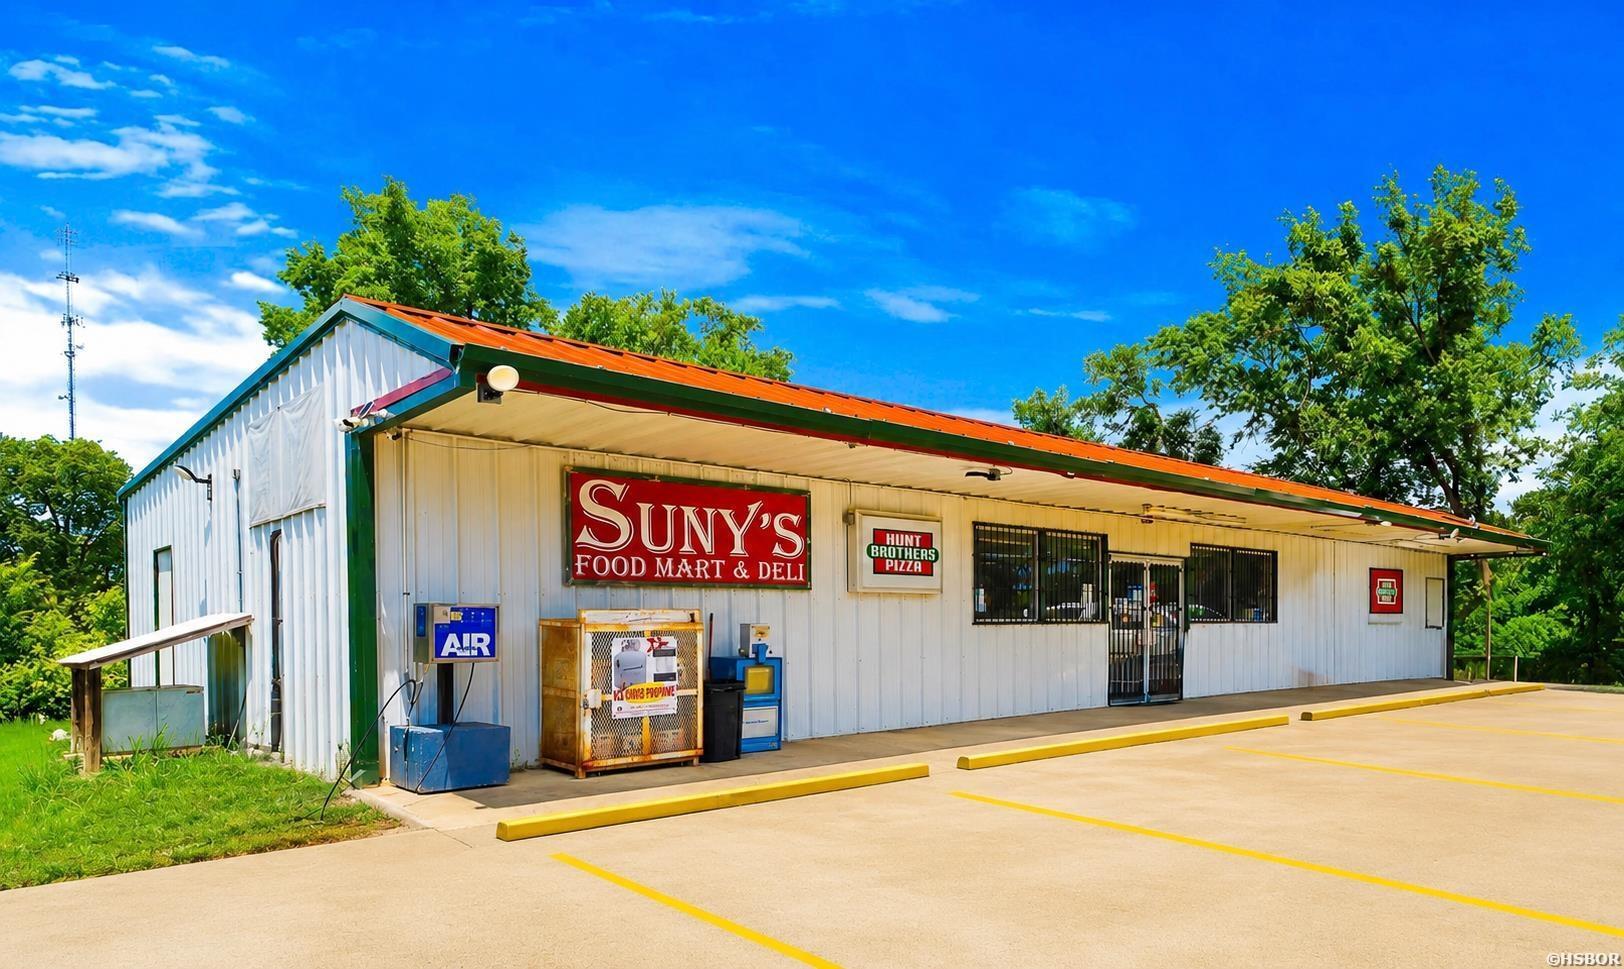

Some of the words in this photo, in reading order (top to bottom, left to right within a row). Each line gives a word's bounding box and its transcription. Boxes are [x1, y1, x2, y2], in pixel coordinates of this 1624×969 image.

[575, 479, 804, 559] SUNY'S
[886, 533, 921, 547] HUNT
[871, 545, 935, 561] BROTHERS
[575, 554, 646, 577] FOOD
[655, 558, 725, 579] MART
[733, 561, 749, 579] &
[758, 561, 805, 581] DELI
[886, 560, 922, 572] PIZZA
[440, 633, 491, 656] AIR
